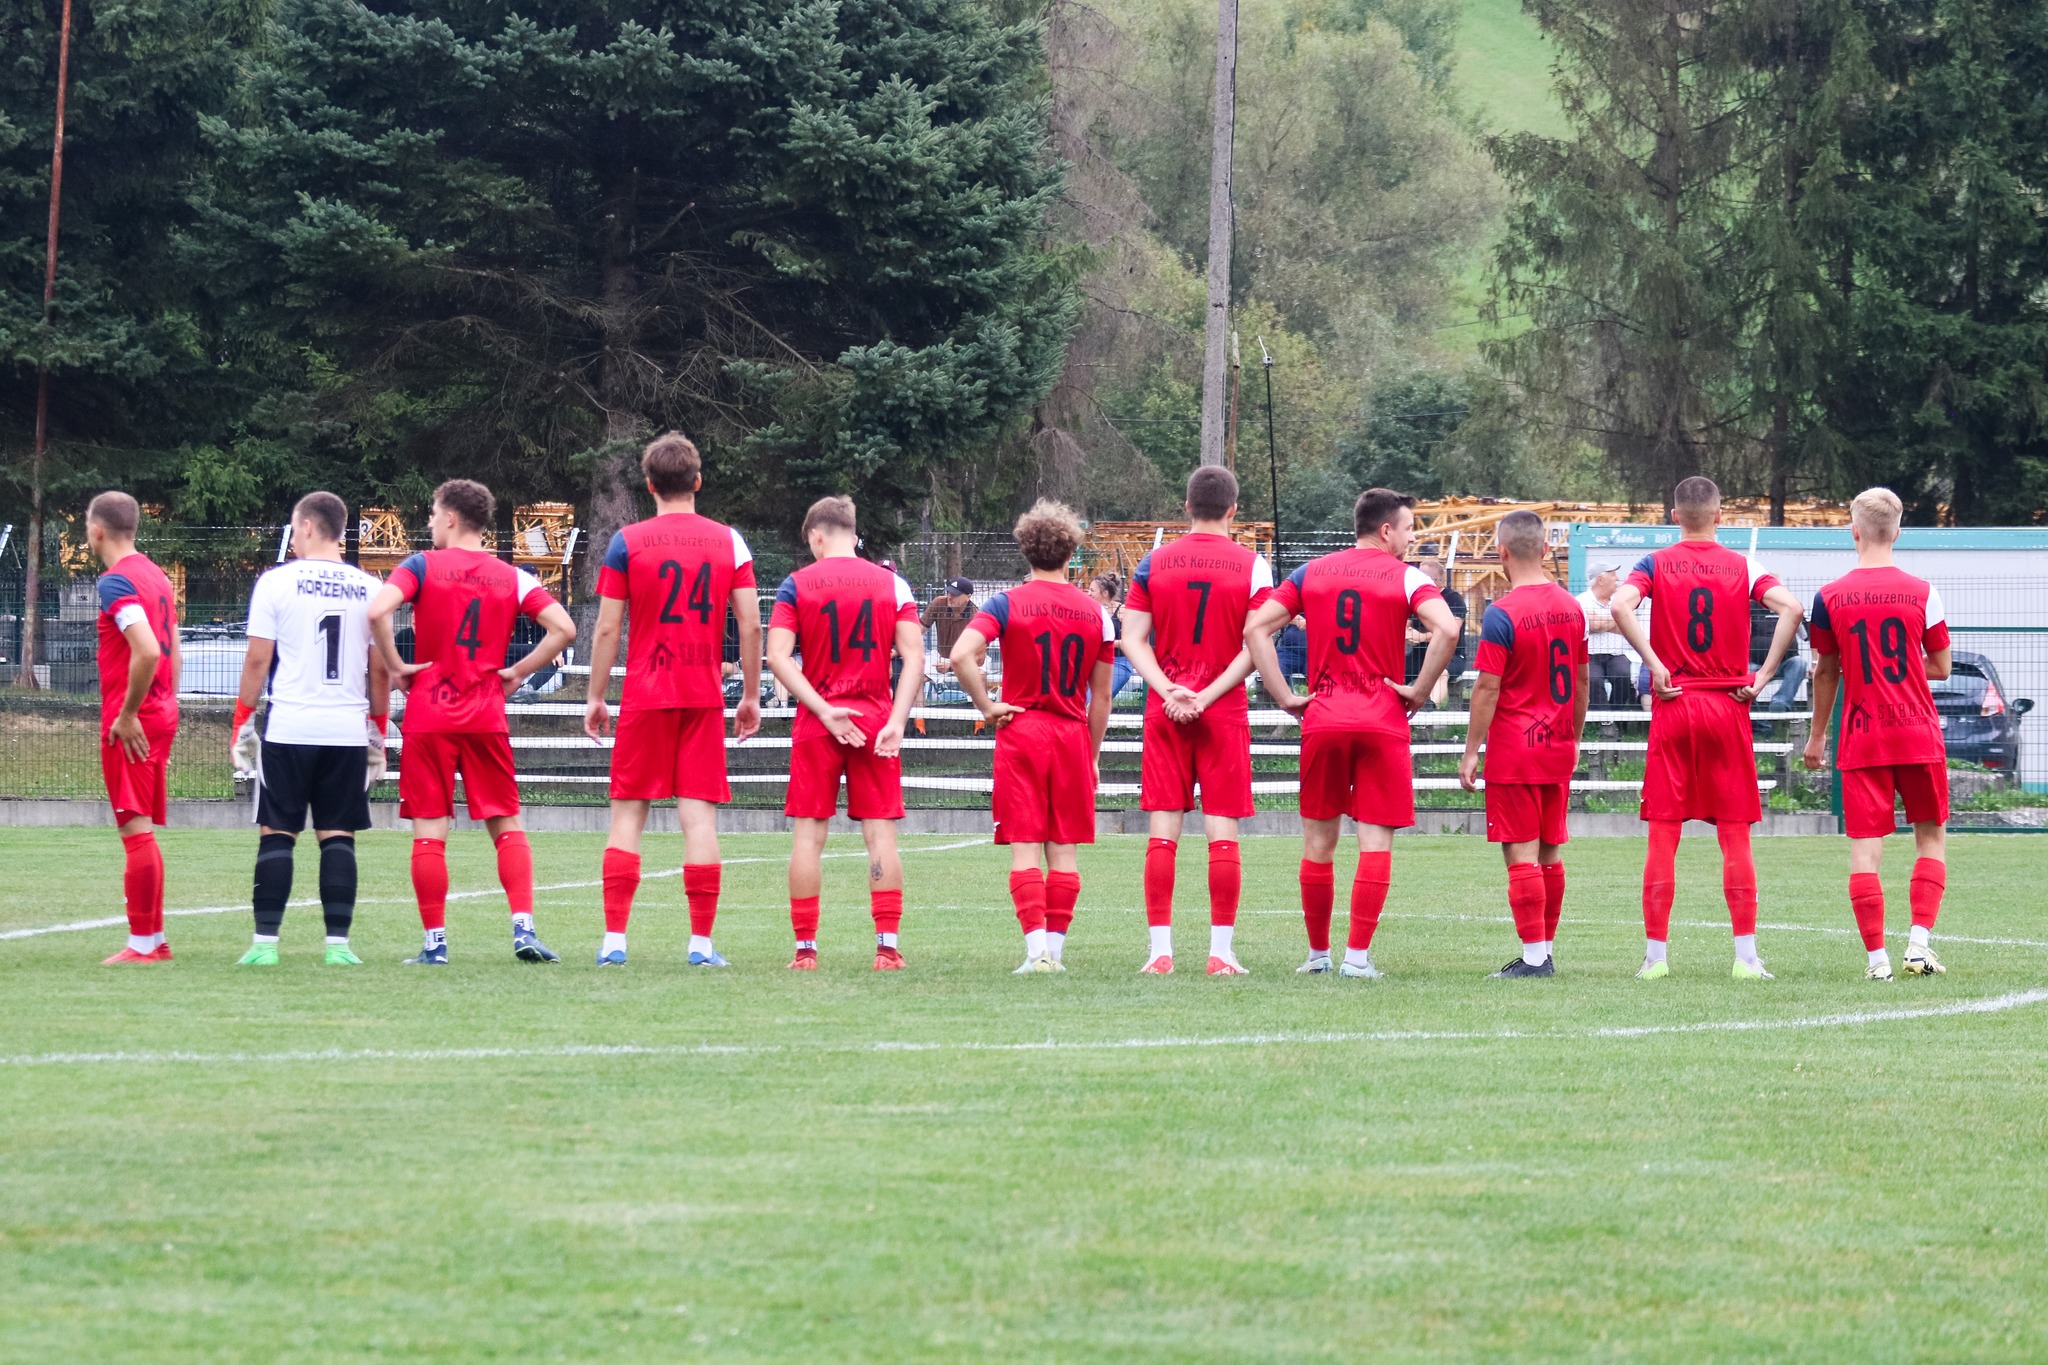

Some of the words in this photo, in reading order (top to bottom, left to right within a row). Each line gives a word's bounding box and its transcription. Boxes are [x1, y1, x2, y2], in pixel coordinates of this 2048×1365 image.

[643, 534, 670, 549] ULKS
[674, 534, 723, 549] Korzenna
[1160, 556, 1186, 571] ULKS
[1190, 555, 1242, 573] Korzenna
[1663, 560, 1688, 574] ULKS
[1691, 561, 1740, 577] Korzenna
[297, 579, 367, 601] KORZENNA
[318, 569, 346, 580] ULKS
[658, 559, 713, 624] 24
[807, 577, 833, 592] ULKS
[1313, 564, 1339, 577] ULKS
[1342, 564, 1394, 582] Korzenna
[1834, 591, 1860, 609] ULKS
[1864, 591, 1918, 607] Korzenna
[159, 595, 172, 657] 3
[455, 598, 482, 661] 4
[821, 599, 877, 664] 14
[1021, 602, 1048, 617] ULKS
[1051, 603, 1097, 625] Korzenna
[1187, 581, 1212, 645] 7
[1335, 588, 1362, 655] 9
[1687, 586, 1713, 654] 8
[316, 611, 345, 683] 1
[1034, 630, 1085, 697] 10
[1549, 637, 1572, 705] 6
[1850, 616, 1908, 685] 19
